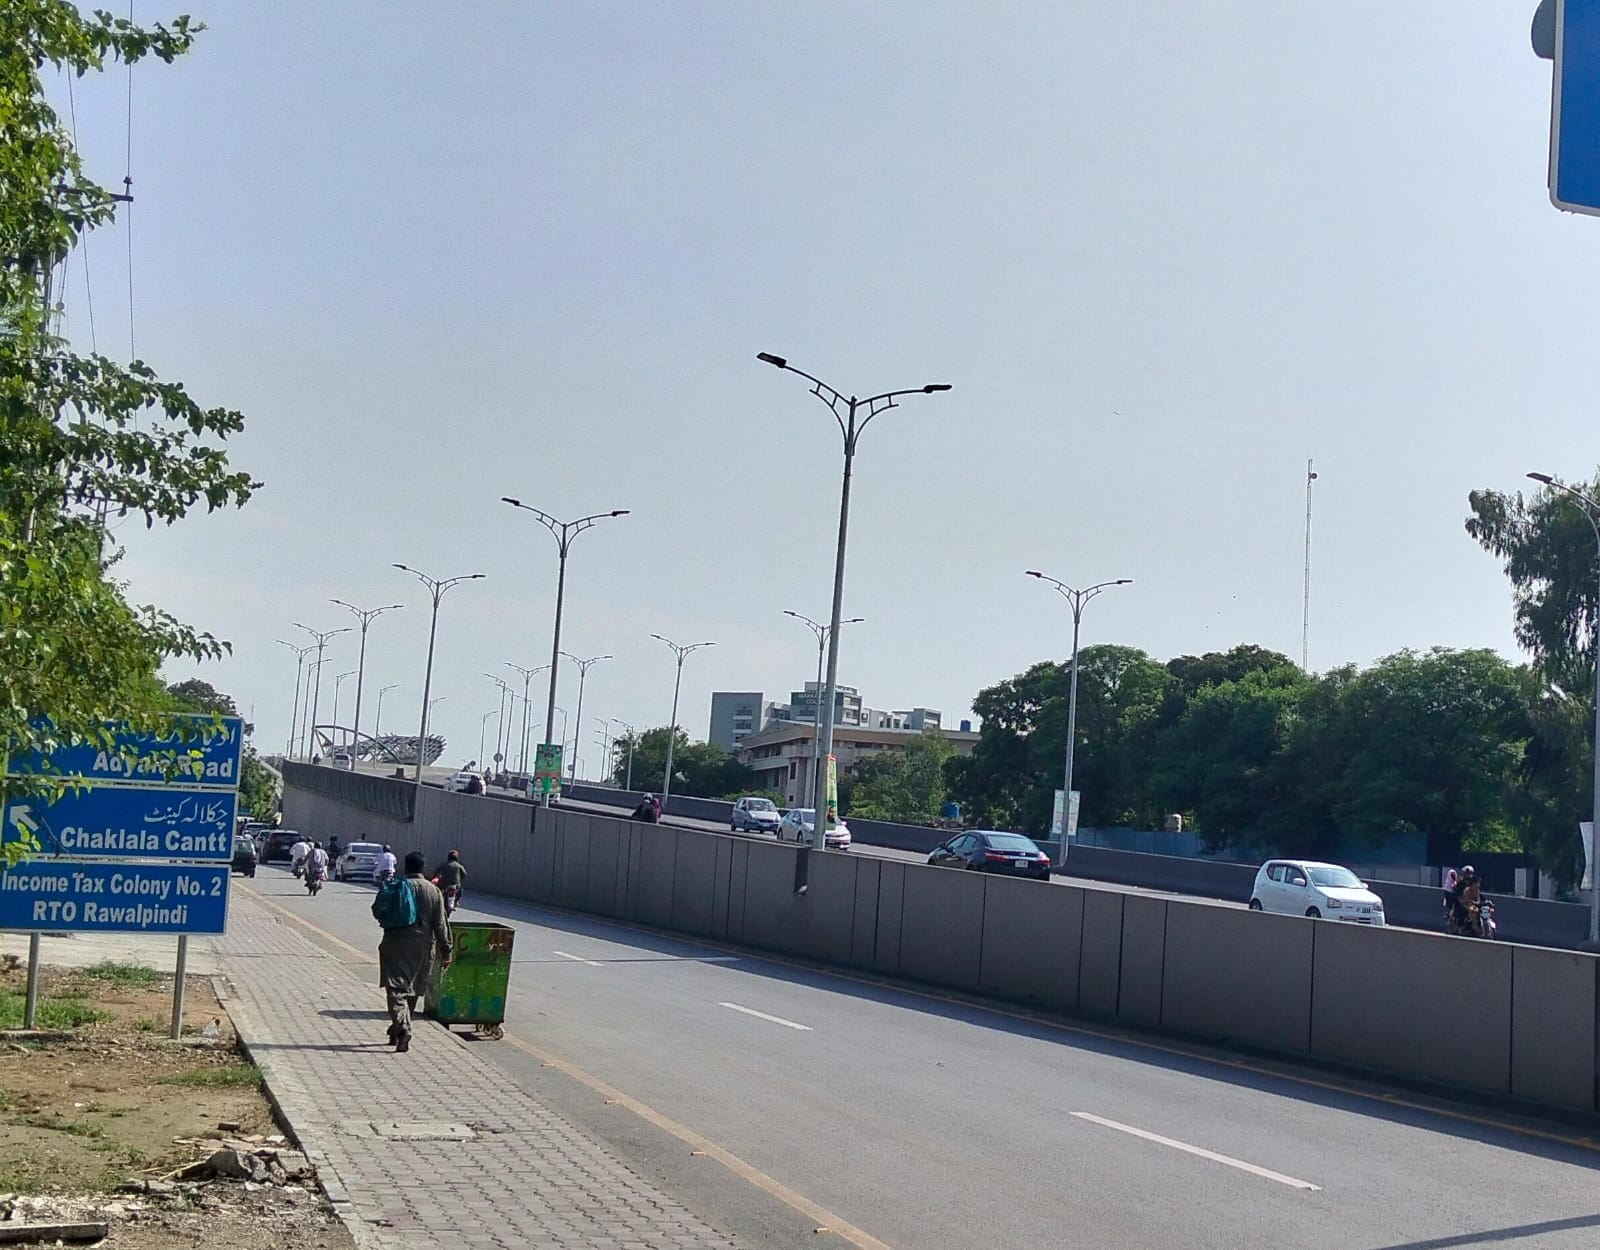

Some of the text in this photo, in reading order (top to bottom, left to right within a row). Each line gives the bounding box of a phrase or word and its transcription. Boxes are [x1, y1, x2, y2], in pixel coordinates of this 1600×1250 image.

[144, 796, 192, 825] کینٹ
[60, 826, 226, 852] Chaklala Cantt
[1, 870, 222, 900] Income Tax Colony No. 2
[33, 900, 188, 928] RTO Rawalpindi
